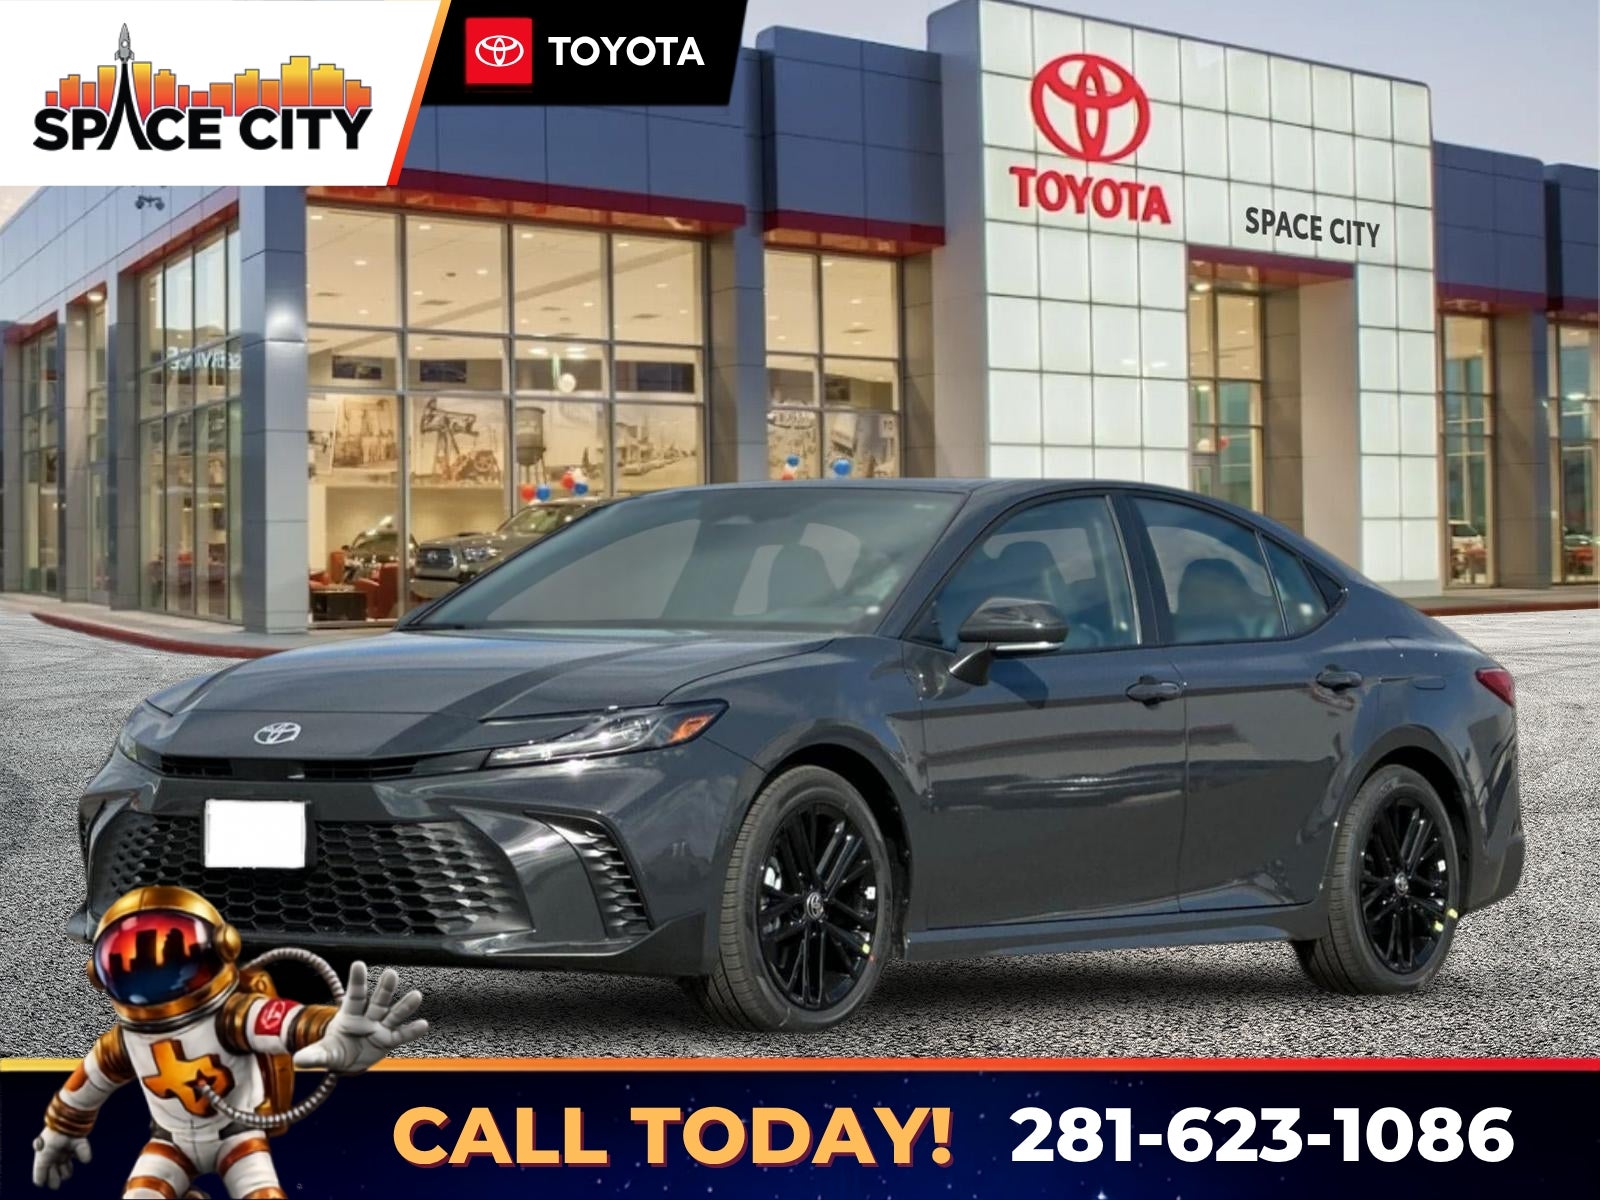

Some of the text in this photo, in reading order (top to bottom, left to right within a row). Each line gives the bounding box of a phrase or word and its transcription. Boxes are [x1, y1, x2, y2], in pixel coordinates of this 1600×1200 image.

[1009, 166, 1171, 224] TOYOTA
[1246, 207, 1380, 248] SPACE CITY
